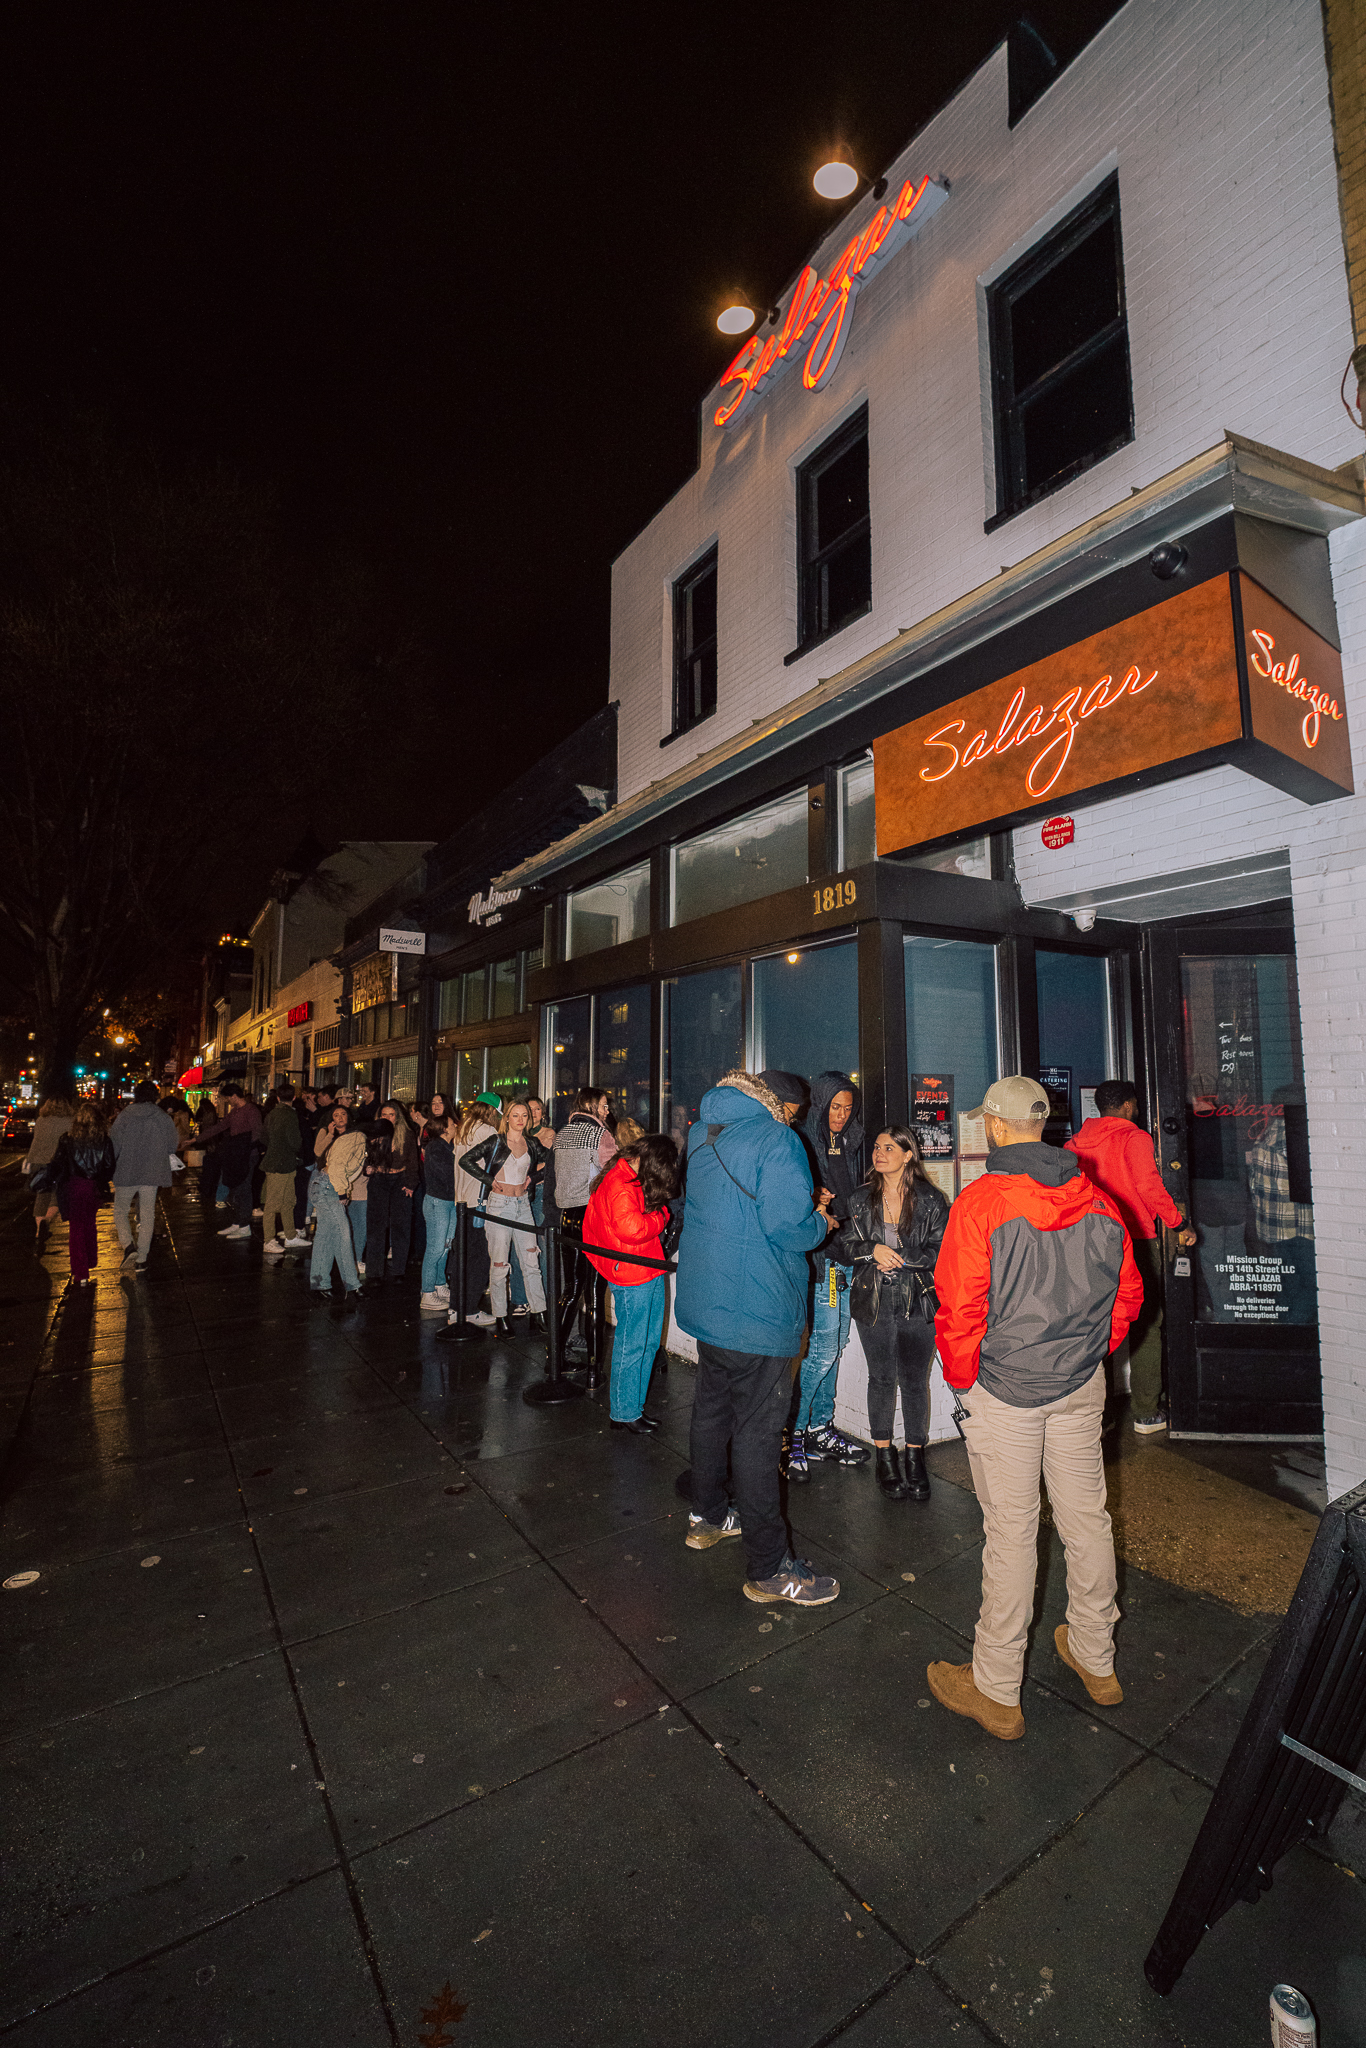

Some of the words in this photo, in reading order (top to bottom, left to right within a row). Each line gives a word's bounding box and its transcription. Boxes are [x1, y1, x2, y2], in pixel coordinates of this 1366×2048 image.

[714, 174, 930, 427] Salazar
[1251, 628, 1343, 748] Salazar
[919, 665, 1158, 797] Salazar
[1054, 821, 1072, 831] ALARM
[1051, 837, 1064, 847] 911
[813, 879, 857, 915] 1819
[916, 1091, 949, 1100] EVENTS
[1193, 1094, 1285, 1140] Salaza
[1226, 1255, 1258, 1264] Mission
[1259, 1256, 1283, 1266] Group
[1214, 1264, 1234, 1272] 1819
[1236, 1265, 1254, 1273] 14th
[1255, 1265, 1279, 1273] Street
[1281, 1265, 1295, 1274] LLC
[1230, 1274, 1244, 1282] dba
[1246, 1274, 1281, 1283] SALAZAR
[1229, 1283, 1282, 1292] ABRA-118970
[1223, 1304, 1247, 1312] through
